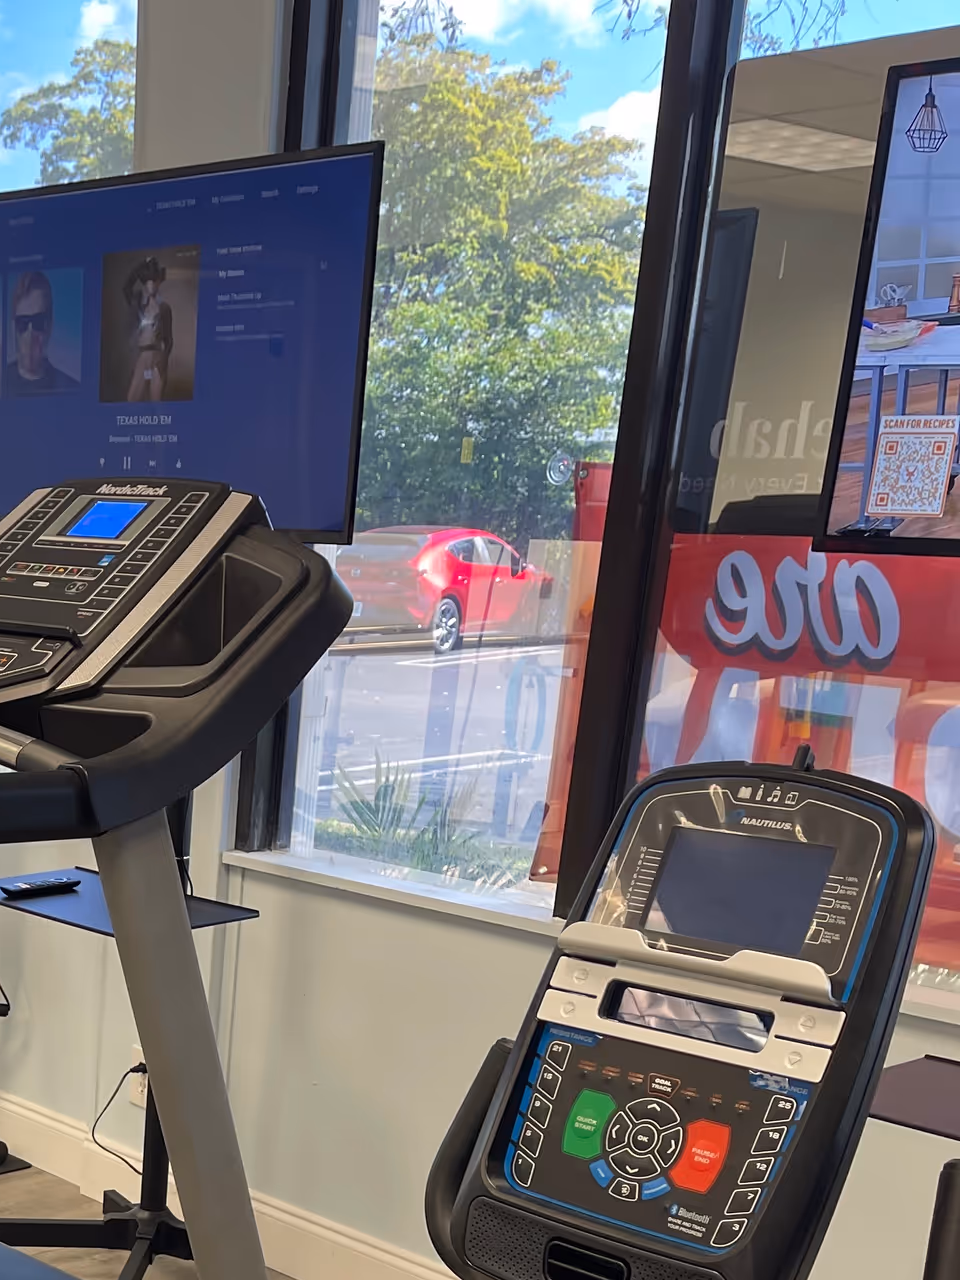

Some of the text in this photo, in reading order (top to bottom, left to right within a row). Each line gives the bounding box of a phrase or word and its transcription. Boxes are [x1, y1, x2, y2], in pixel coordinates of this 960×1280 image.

[116, 415, 138, 426] TEXAS
[139, 415, 158, 425] HOLD
[883, 418, 956, 429] SCAN FOR RECIPES
[96, 484, 168, 495] NordicTrack
[552, 1044, 562, 1052] 21
[544, 1072, 553, 1080] 15
[654, 1078, 672, 1087] GOAL
[651, 1083, 672, 1093] TRACK
[777, 1101, 792, 1109] 25
[576, 1116, 598, 1125] QUICK
[574, 1122, 596, 1131] START
[525, 1129, 532, 1137] 5
[768, 1131, 780, 1139] 18
[637, 1134, 649, 1142] OK
[694, 1155, 710, 1164] END
[756, 1162, 767, 1171] 12
[677, 1207, 712, 1224] Bluetooth
[732, 1223, 740, 1231] 3
